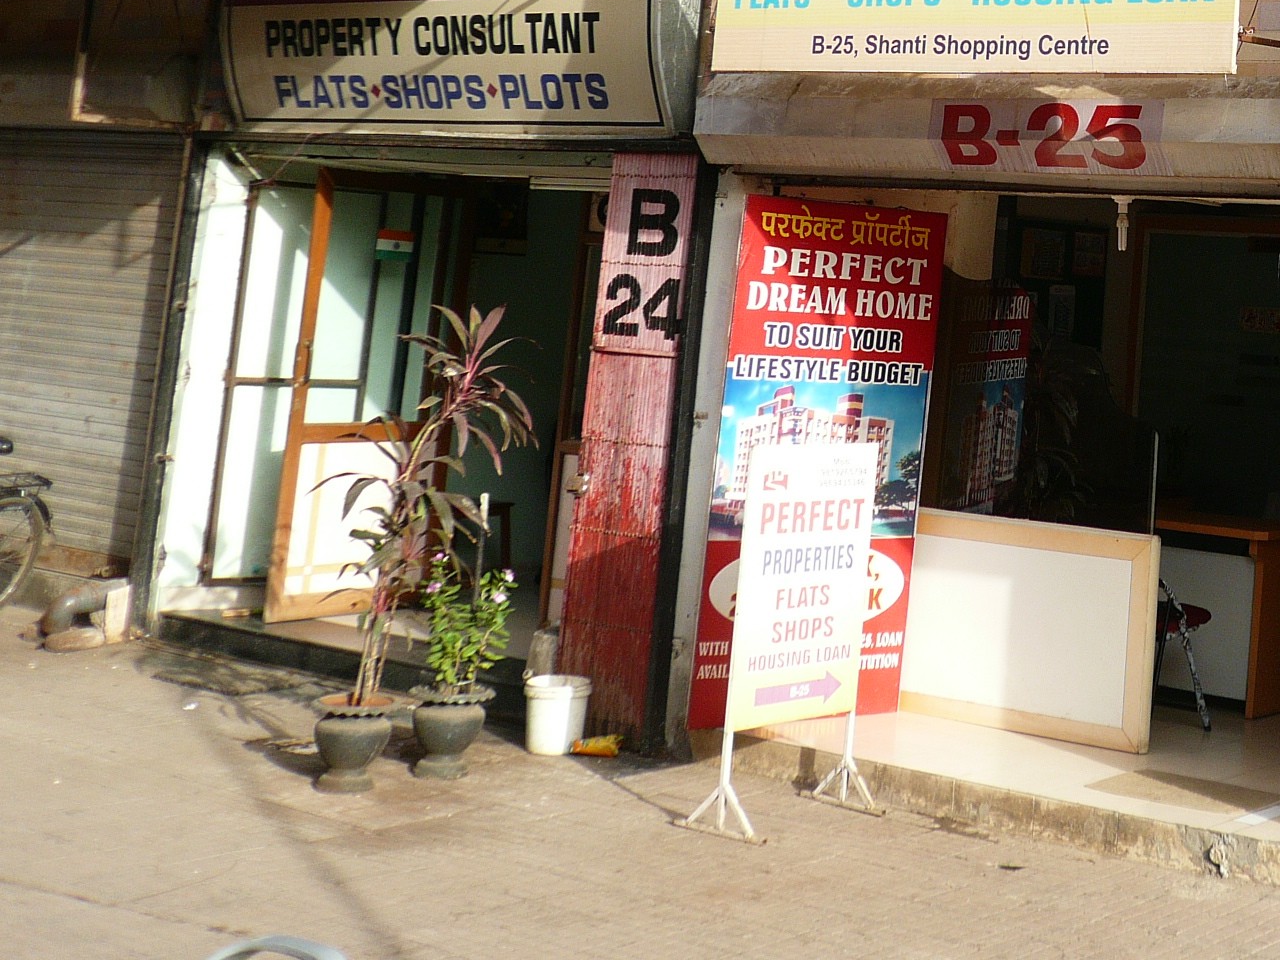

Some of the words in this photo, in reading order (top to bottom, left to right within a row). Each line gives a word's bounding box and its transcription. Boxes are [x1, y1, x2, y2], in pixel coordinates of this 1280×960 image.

[266, 18, 402, 57] PROPERTY
[414, 12, 599, 55] CONSULTANT
[812, 35, 859, 58] B-25,
[865, 34, 927, 56] Shanti
[933, 34, 1031, 61] Shopping
[1037, 34, 1109, 56] Centre
[274, 75, 369, 108] FLATS
[380, 74, 486, 109] SHOPS
[499, 73, 608, 109] PLOTS
[940, 103, 1148, 171] B-25
[627, 189, 680, 257] B
[760, 245, 928, 285] PERFECT
[603, 274, 683, 340] 24
[746, 281, 847, 316] DREAM
[854, 289, 933, 321] HOME
[765, 323, 791, 347] TO
[798, 325, 844, 349] SUIT
[850, 328, 902, 352] YOUR
[735, 356, 840, 381] LIFESTYLE
[847, 361, 923, 386] BUDGET
[760, 499, 865, 534] PERFECT
[762, 544, 854, 575] PROPERTIES
[775, 585, 831, 610] FLATS
[772, 616, 834, 643] SHOPS
[699, 642, 729, 657] WITH
[748, 649, 810, 672] HOUSING
[817, 644, 852, 663] LOAN
